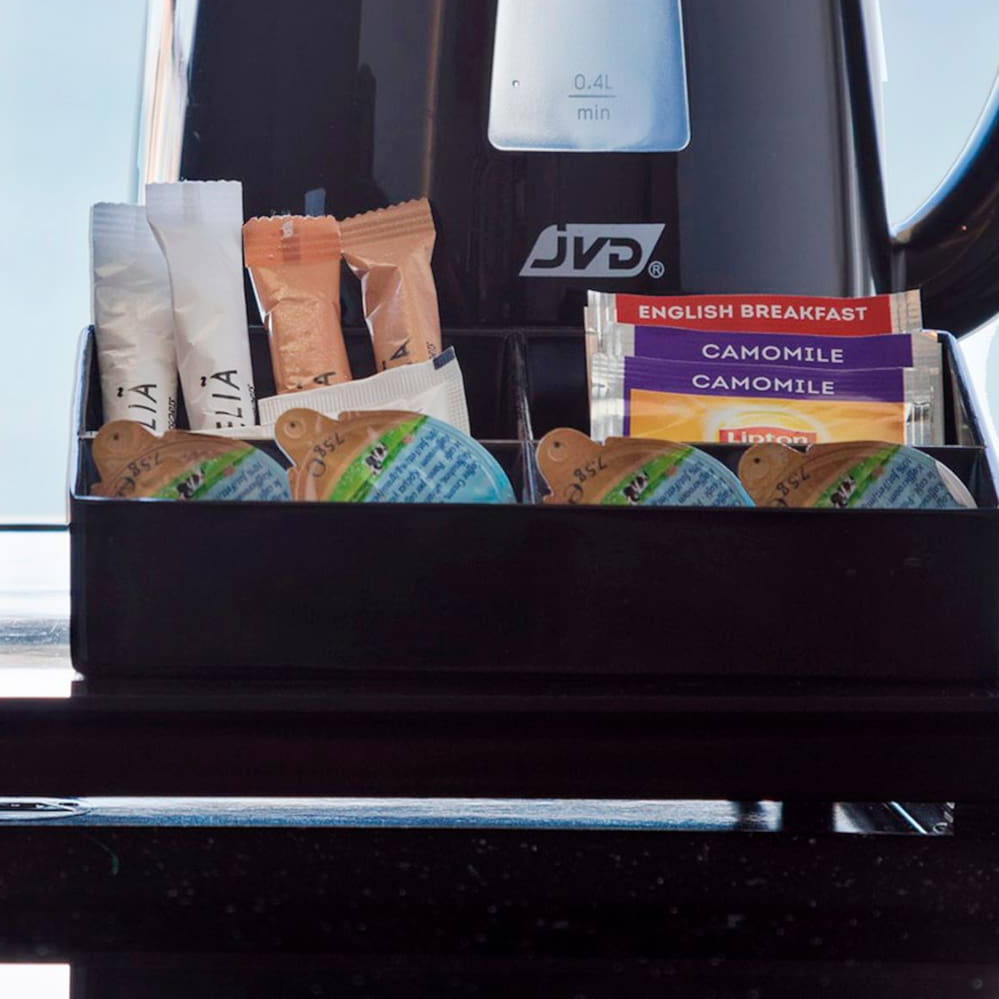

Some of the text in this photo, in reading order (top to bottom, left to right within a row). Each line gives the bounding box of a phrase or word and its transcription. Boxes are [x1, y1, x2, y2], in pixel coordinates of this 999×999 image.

[574, 73, 614, 90] 0.4L
[577, 103, 611, 121] min
[637, 303, 868, 322] ENGLISH BREAKFAST
[701, 343, 844, 364] CAMOMILE
[691, 373, 835, 395] CAMOMILE
[727, 430, 809, 445] Lipton
